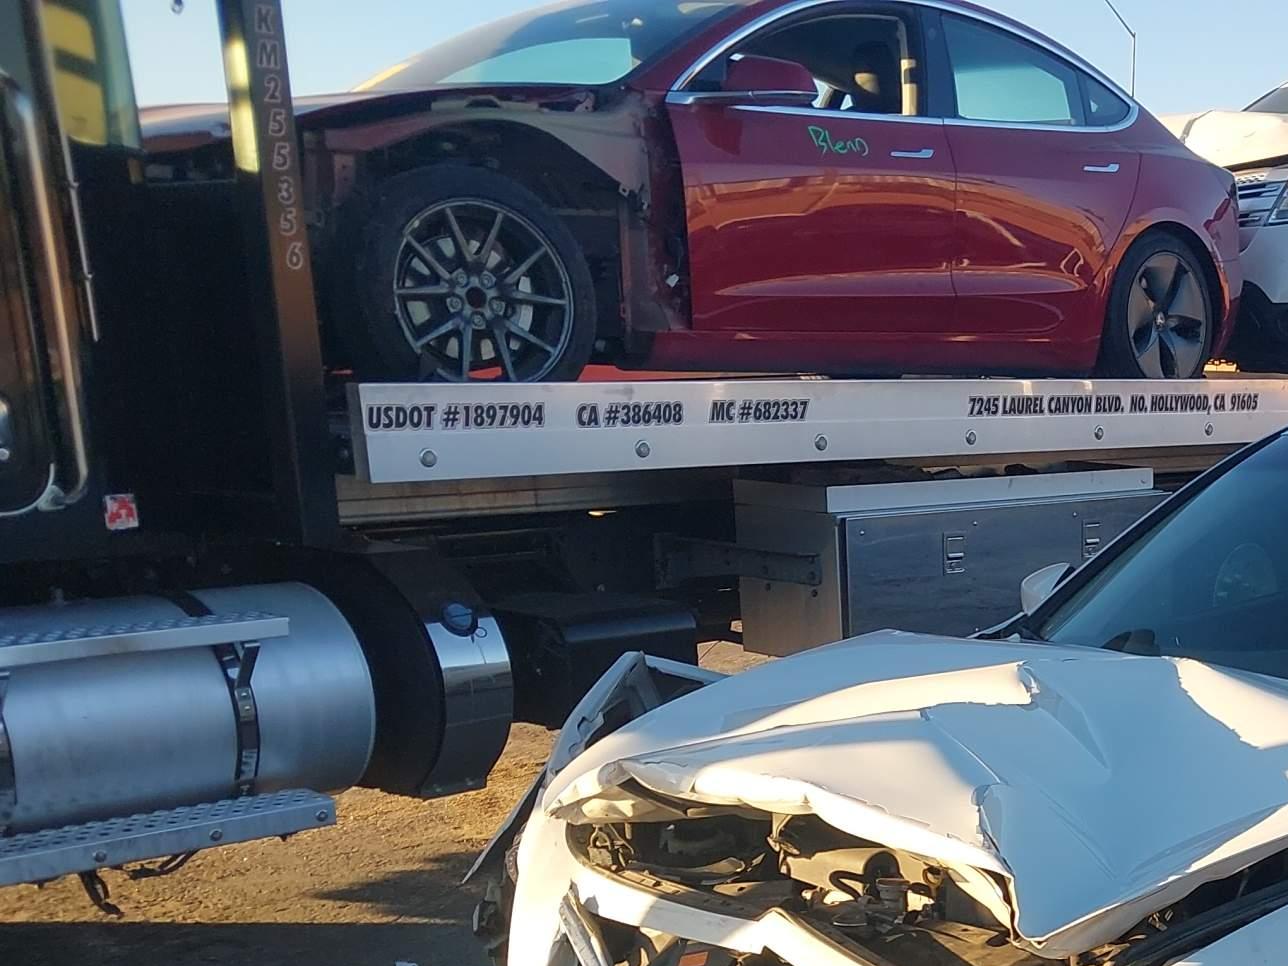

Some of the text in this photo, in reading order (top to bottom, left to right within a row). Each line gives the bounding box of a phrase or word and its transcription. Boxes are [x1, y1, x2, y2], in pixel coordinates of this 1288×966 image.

[366, 402, 545, 430] USDOT #1897904
[576, 402, 683, 427] CA #386408
[710, 399, 809, 422] MC #682337
[969, 396, 999, 416] 7245
[1001, 395, 1045, 415] LAUREL
[1048, 395, 1092, 414] CANYON
[1094, 394, 1124, 414] BLVD.
[1151, 393, 1212, 415] HOLLYWOOD,
[1214, 393, 1226, 412] CA
[1231, 392, 1259, 410] 91605
